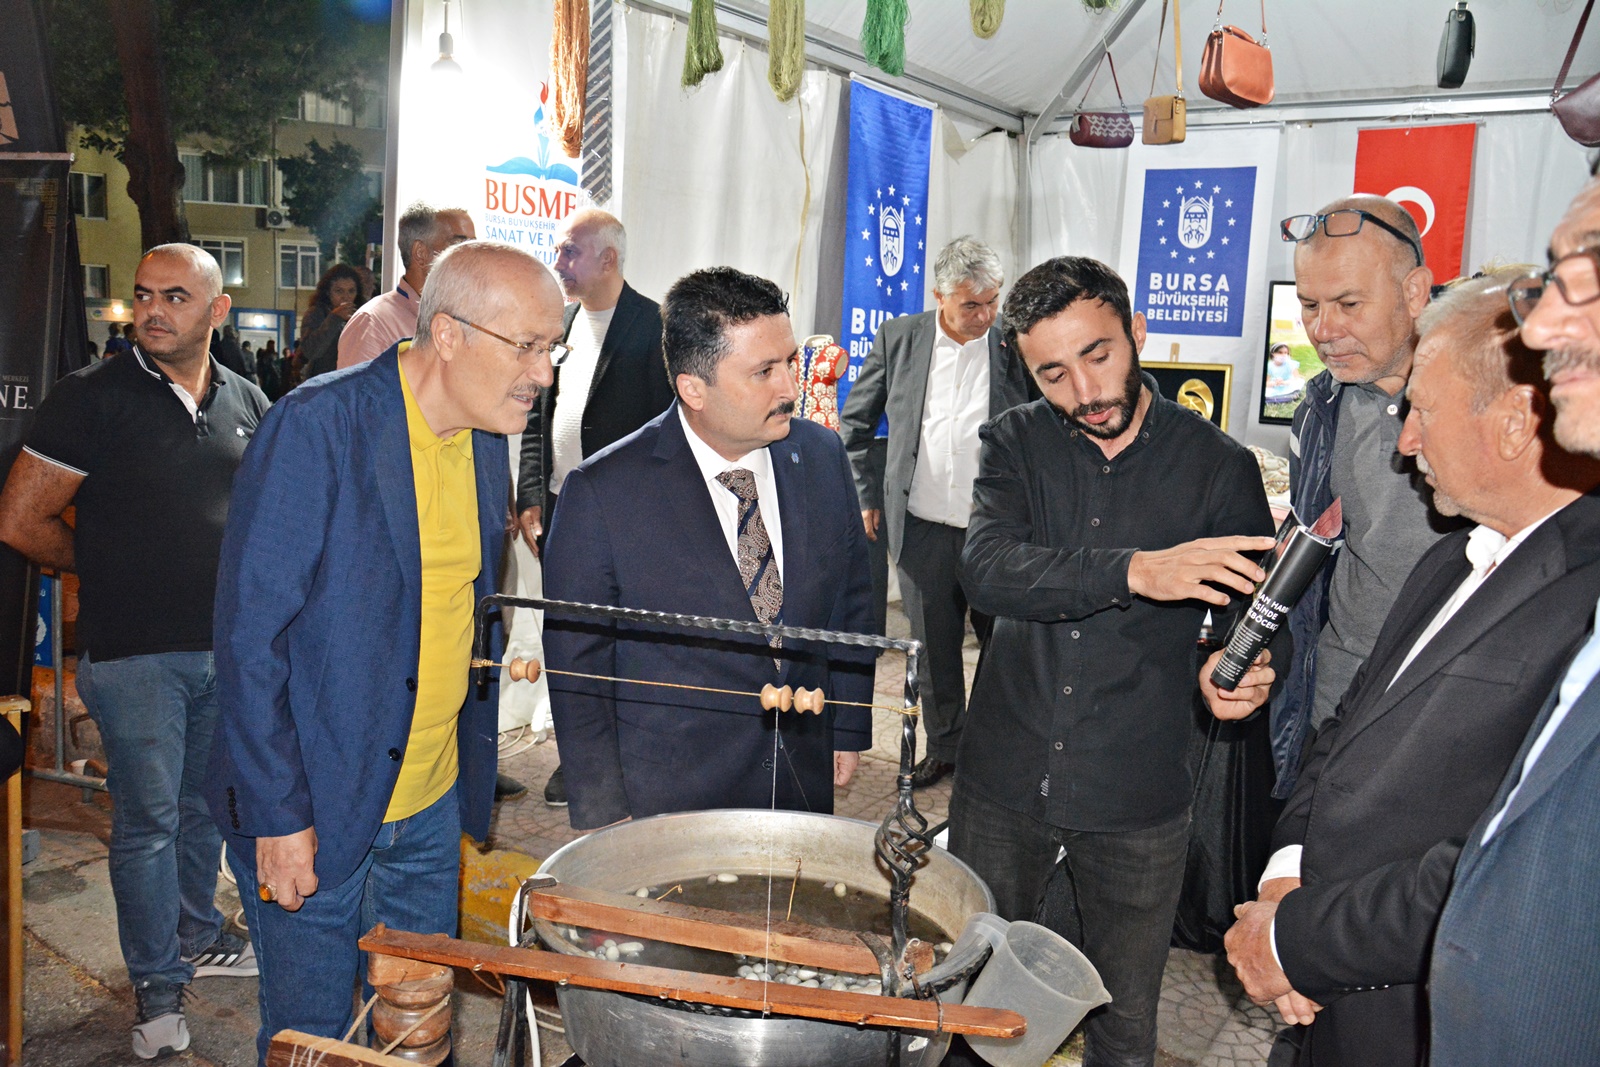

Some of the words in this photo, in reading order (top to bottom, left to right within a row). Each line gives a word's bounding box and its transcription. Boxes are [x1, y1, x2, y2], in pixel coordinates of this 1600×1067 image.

[485, 225, 524, 244] SANAT
[528, 231, 544, 246] VE
[1149, 272, 1230, 292] BURSA
[1148, 291, 1229, 308] BÜYÜKŞEHİR
[1147, 307, 1229, 323] BELEDİYESİ
